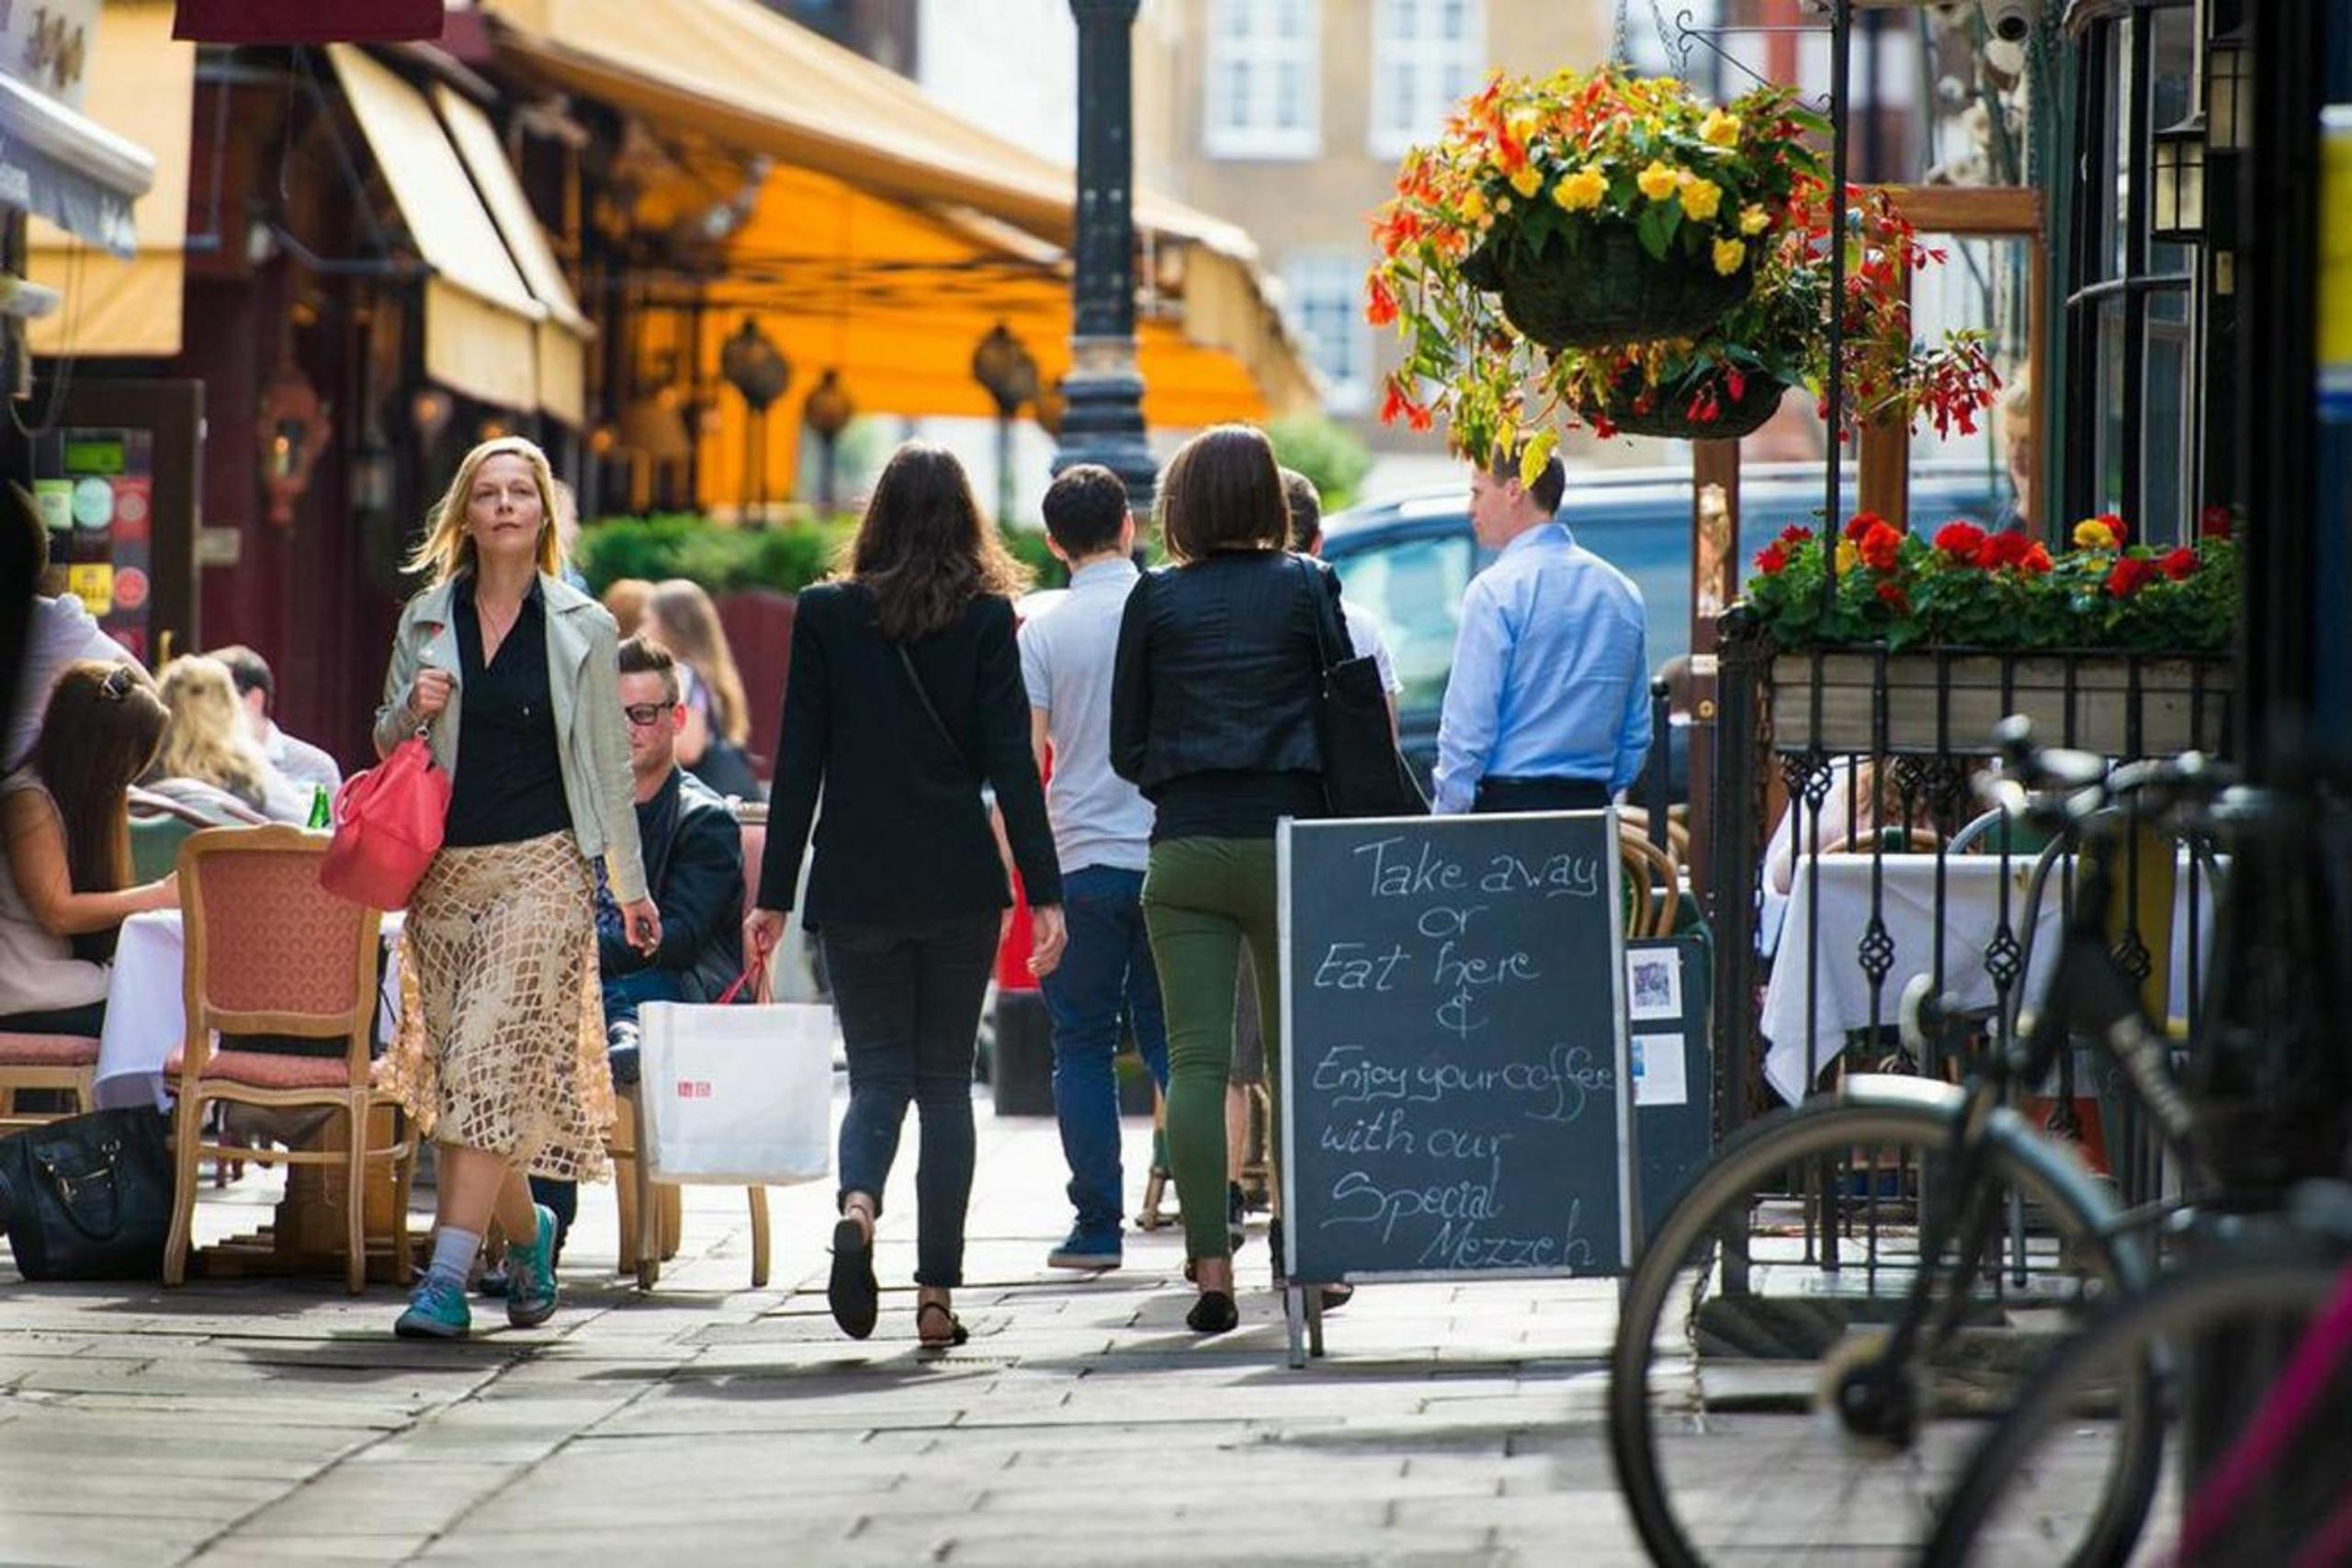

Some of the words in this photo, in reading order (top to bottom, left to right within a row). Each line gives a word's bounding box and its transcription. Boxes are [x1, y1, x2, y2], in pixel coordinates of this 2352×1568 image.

[1353, 837, 1468, 897] Take
[1480, 854, 1599, 898] away
[1314, 942, 1412, 991] Eat
[1433, 941, 1541, 988] here
[1436, 985, 1489, 1039] &
[1313, 1044, 1408, 1108] Enjoy
[1408, 1065, 1502, 1102] your
[1320, 1108, 1415, 1154] with
[1428, 1123, 1514, 1158] our
[1319, 1156, 1504, 1245] Special
